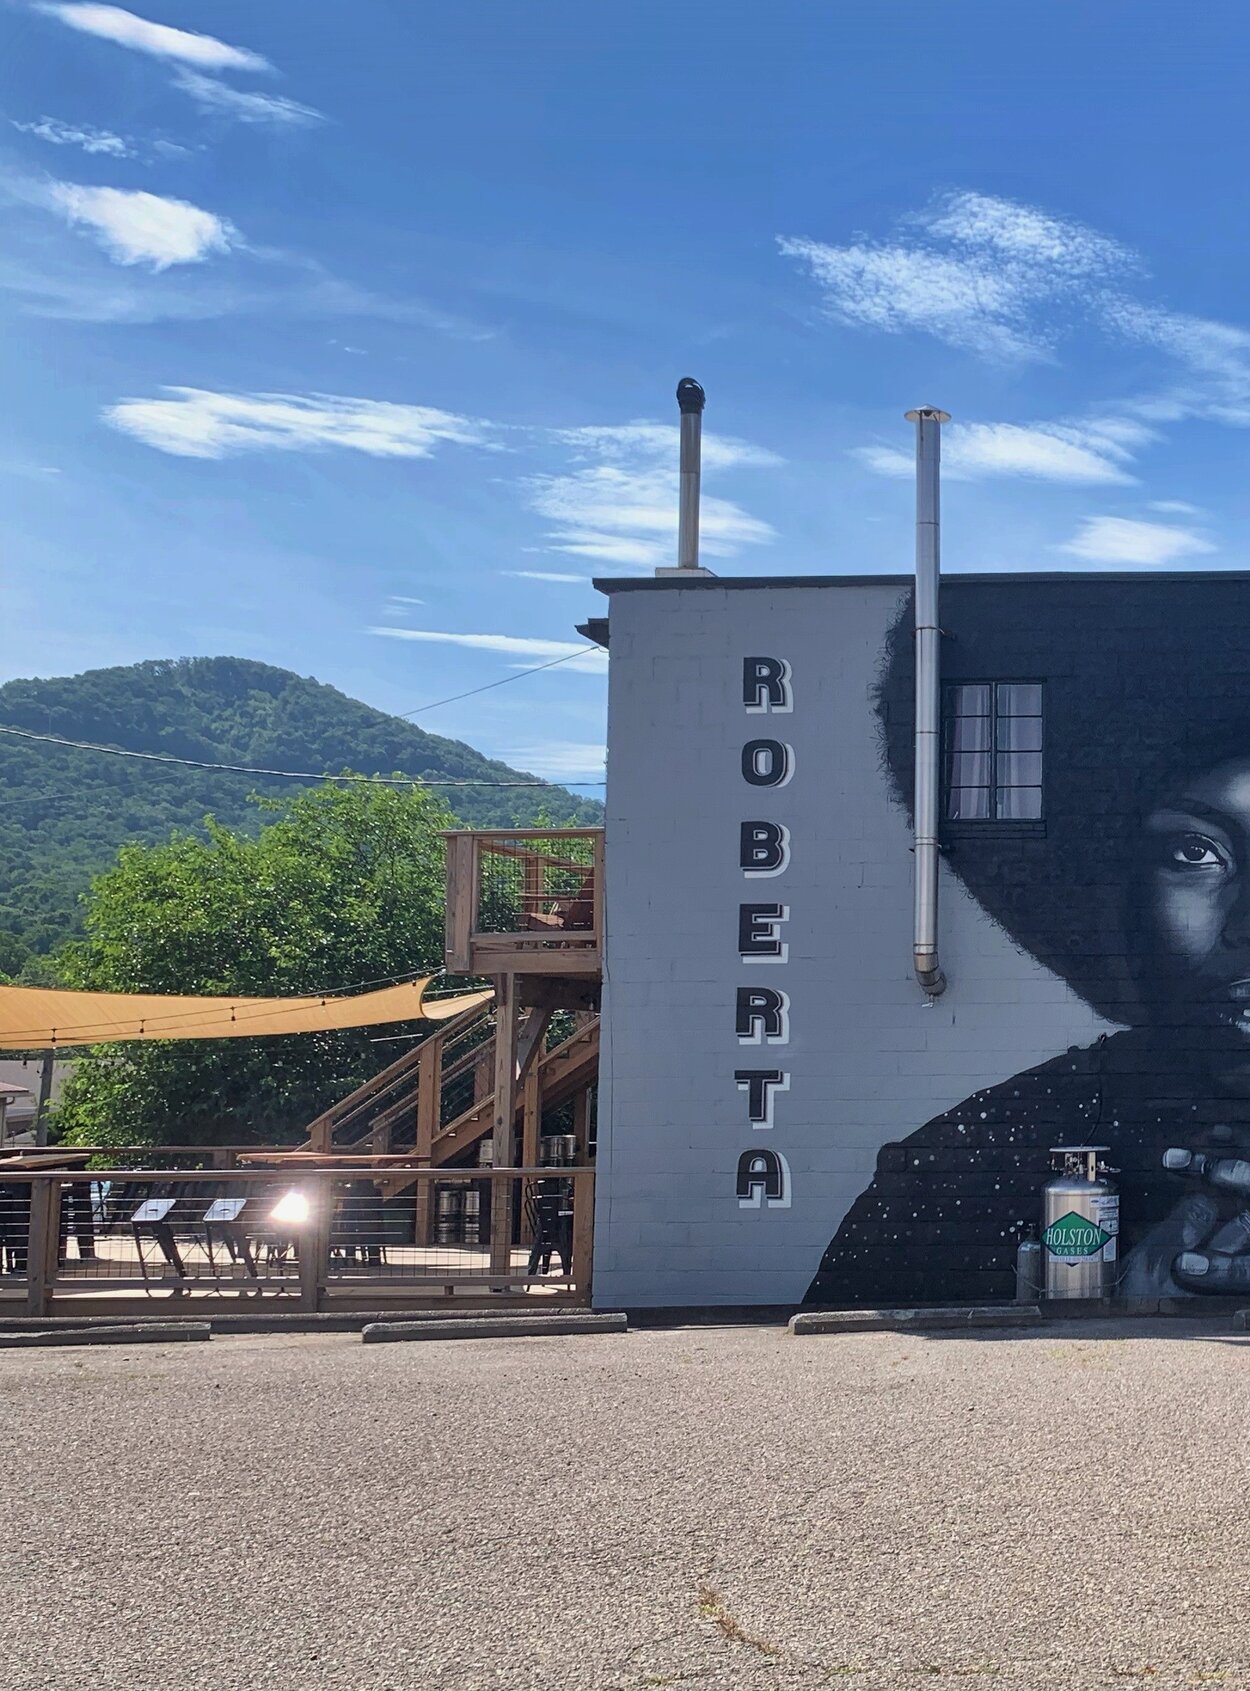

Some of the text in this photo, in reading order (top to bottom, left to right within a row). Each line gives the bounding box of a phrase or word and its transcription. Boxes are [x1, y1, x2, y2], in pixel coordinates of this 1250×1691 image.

[734, 656, 794, 1209] ROBERTA
[1046, 1228, 1101, 1246] HOLSTON
[1056, 1247, 1088, 1255] GASES
